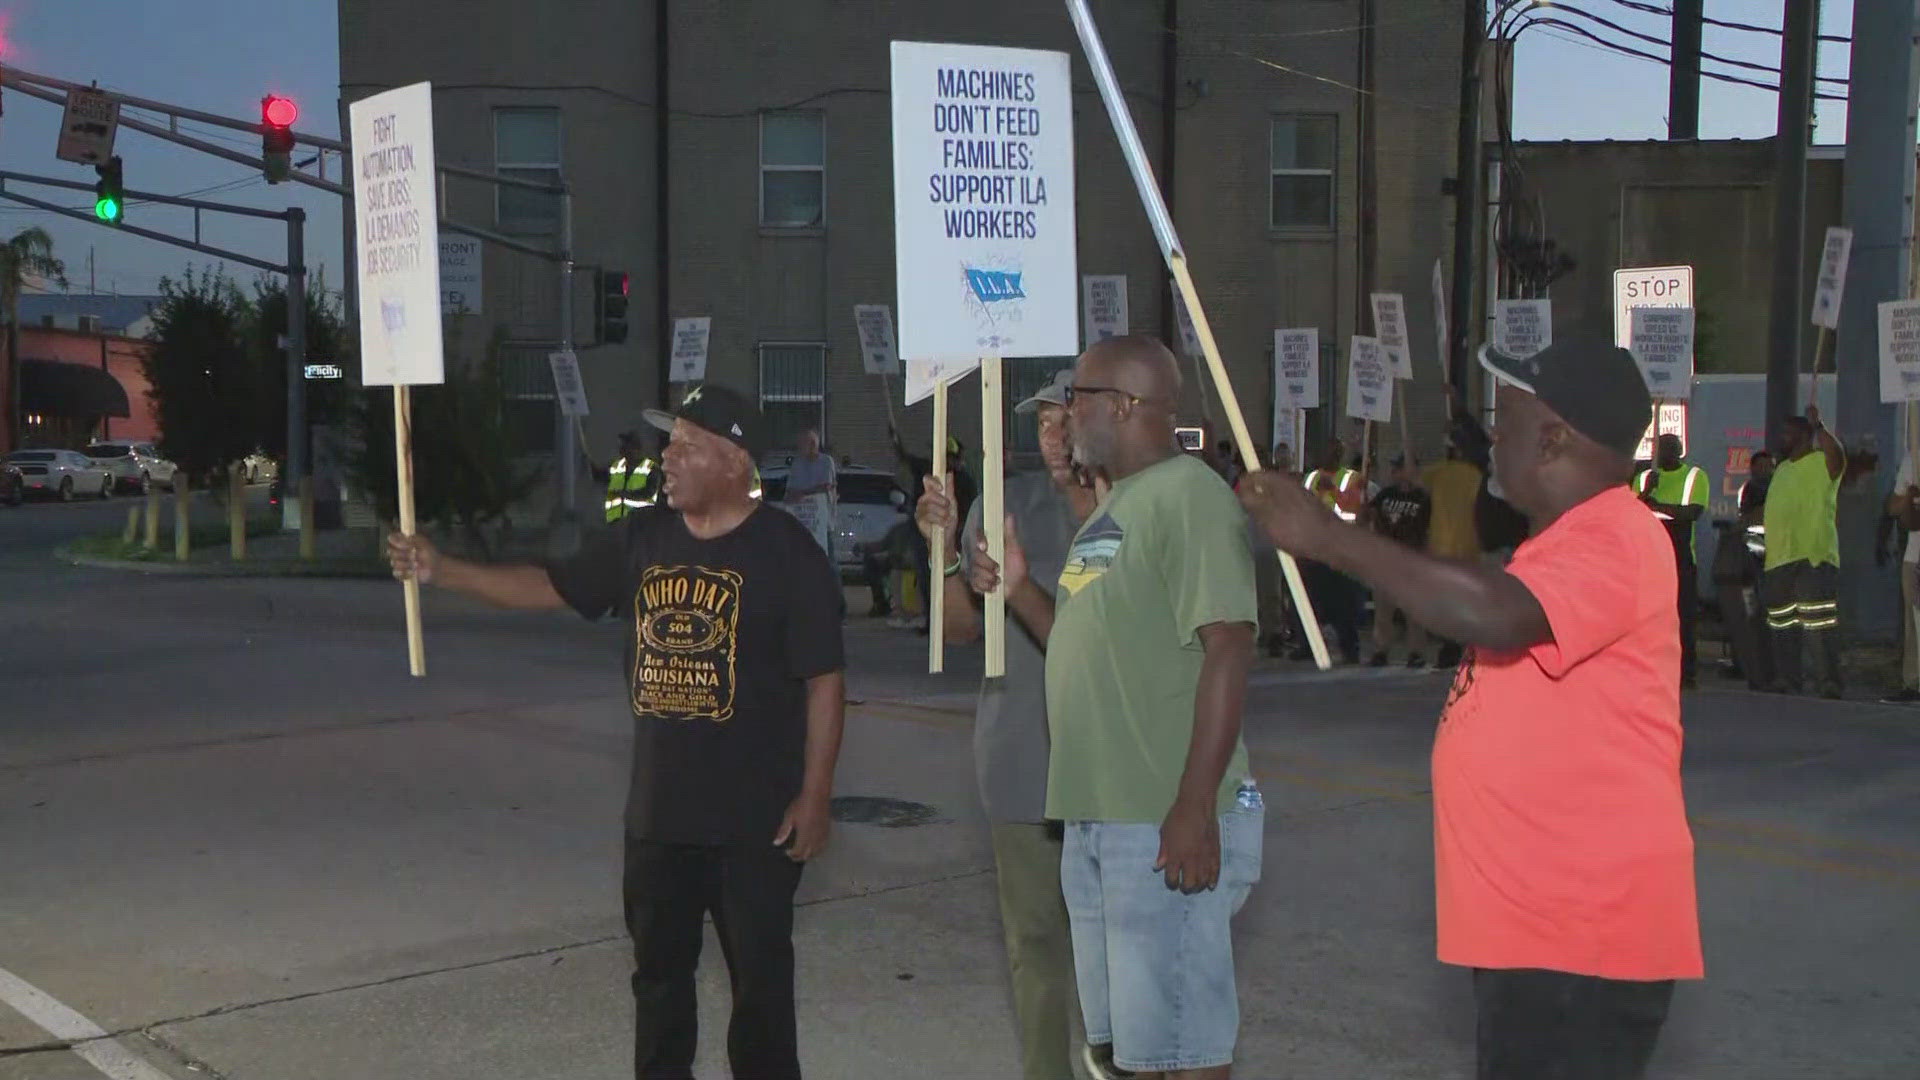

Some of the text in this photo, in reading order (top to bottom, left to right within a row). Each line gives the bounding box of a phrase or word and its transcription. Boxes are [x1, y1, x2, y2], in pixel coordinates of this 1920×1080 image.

[938, 69, 1035, 102] MACHINES
[373, 115, 396, 146] FIGHT
[934, 103, 1040, 136] DON'T FEED
[943, 139, 1034, 171] FAMILIES:
[367, 182, 386, 212] SAVE
[930, 173, 1048, 206] SUPPORT ILA
[378, 208, 421, 242] DEMANDS
[944, 209, 1037, 240] WORKERS
[378, 242, 422, 275] SECURITY
[1627, 279, 1680, 298] STOP
[643, 577, 731, 614] WHO DAT
[668, 622, 693, 635] 504
[639, 667, 719, 686] LOUISIANA
[644, 653, 715, 671] New Orleans
